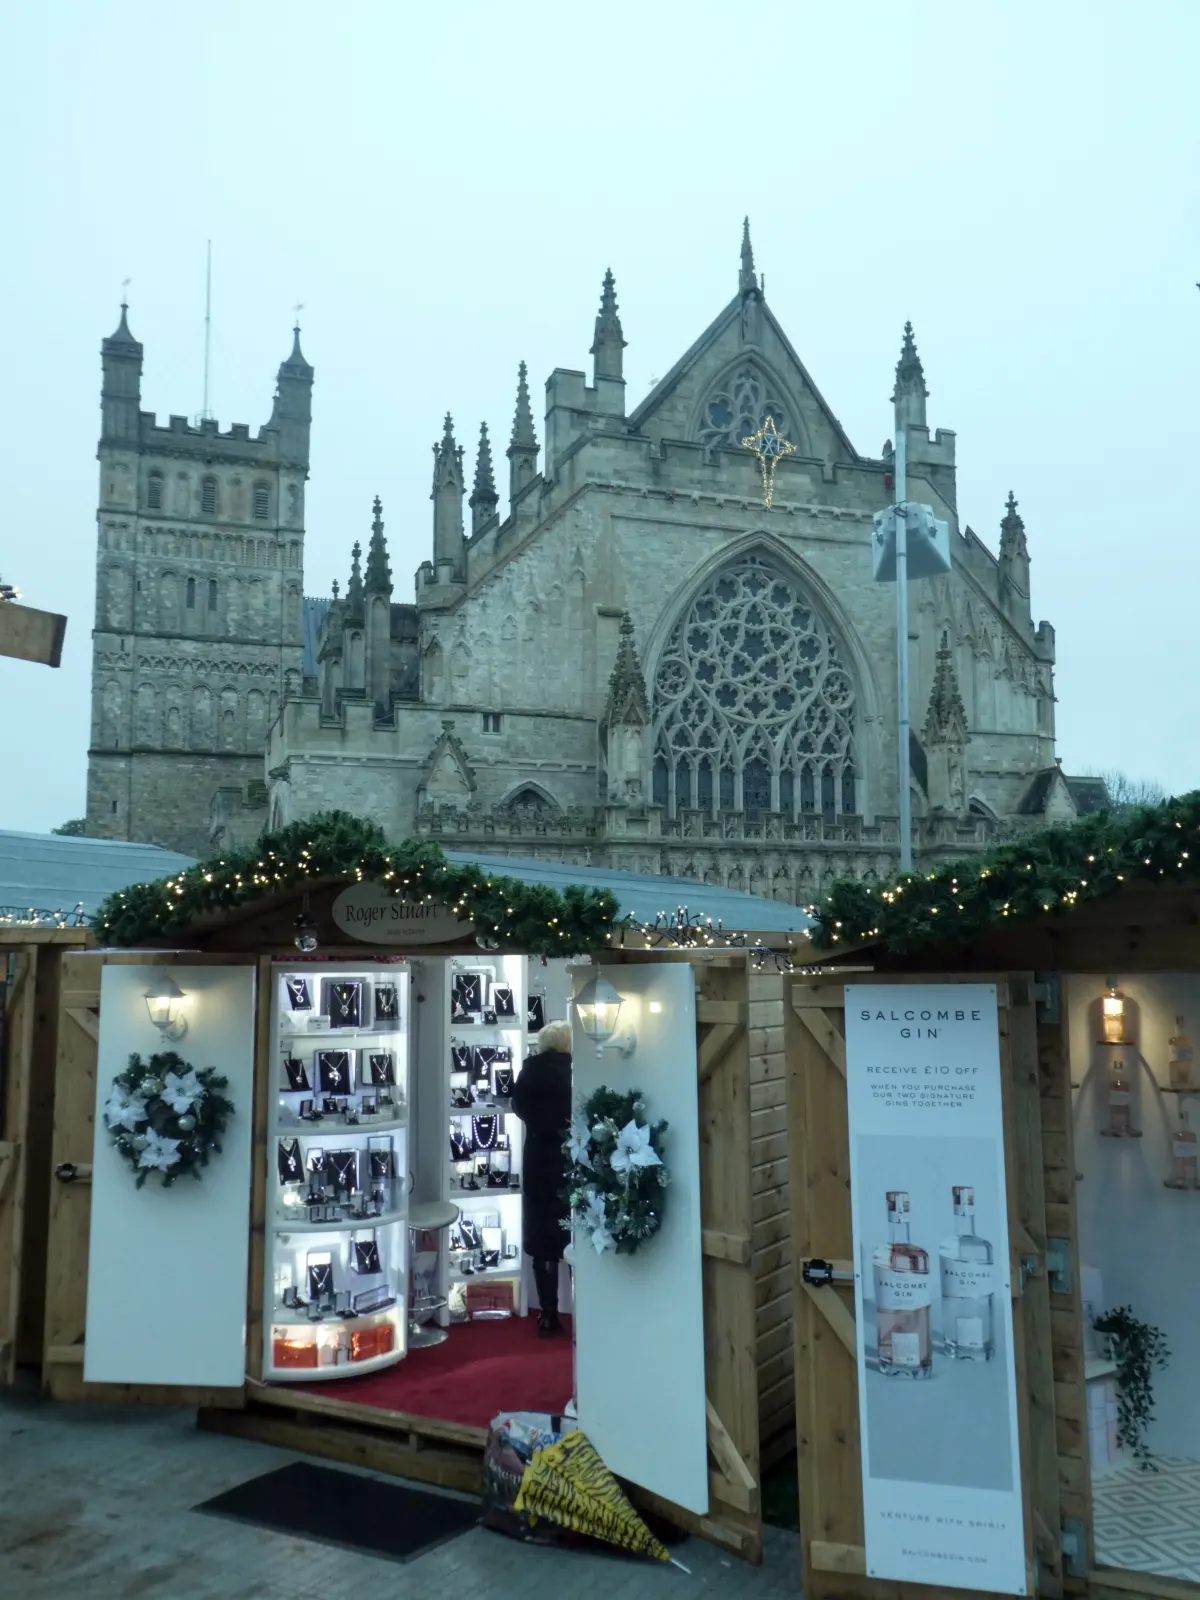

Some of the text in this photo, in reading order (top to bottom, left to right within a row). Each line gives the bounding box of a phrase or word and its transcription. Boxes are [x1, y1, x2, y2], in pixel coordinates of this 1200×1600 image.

[345, 902, 439, 927] Roger Stuart
[860, 1010, 981, 1021] SALCOMBE
[900, 1028, 938, 1039] GIN
[866, 1065, 978, 1075] RECEIVE £10 OFF
[924, 1084, 977, 1092] PURCHASE
[919, 1092, 975, 1100] SIGNATURE
[912, 1100, 963, 1108] TOGETHER
[944, 1269, 991, 1278] SALCOMBE
[878, 1280, 928, 1289] SALCOMBE
[880, 1511, 1006, 1530] VENTURE WITH SPIRIT
